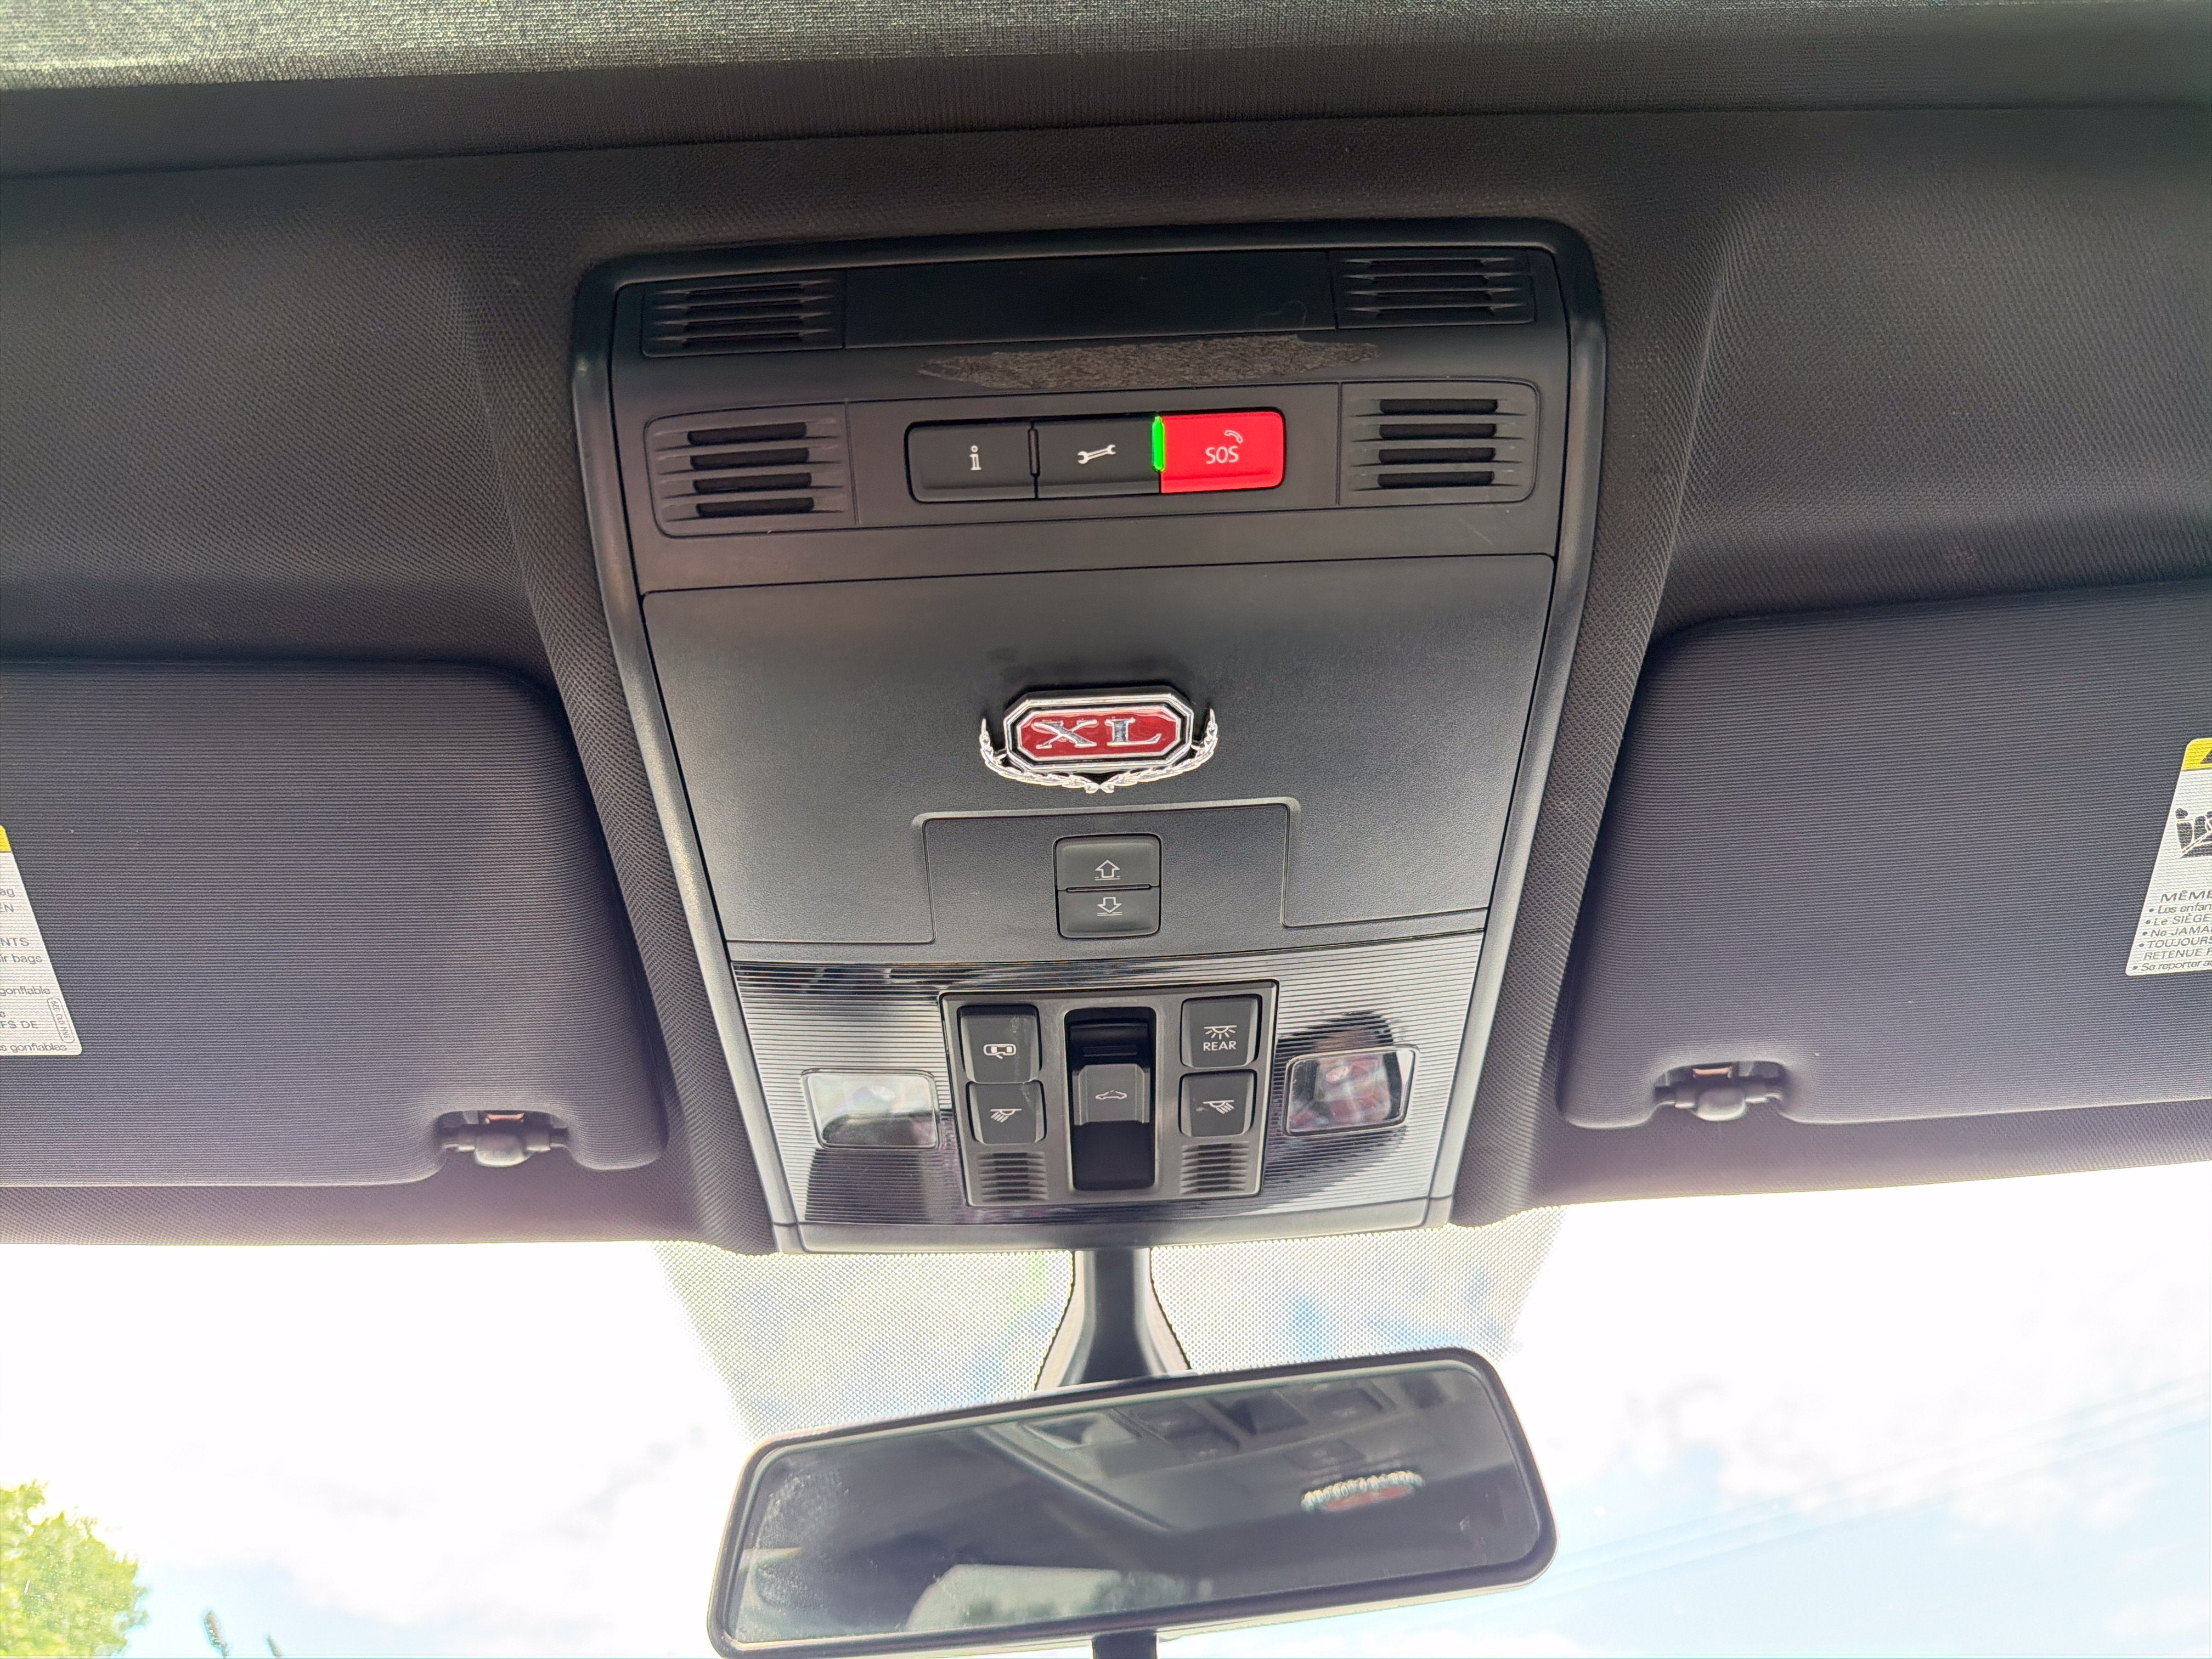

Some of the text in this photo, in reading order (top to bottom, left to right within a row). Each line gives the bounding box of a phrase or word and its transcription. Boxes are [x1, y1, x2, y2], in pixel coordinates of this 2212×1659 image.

[1205, 446, 1239, 464] SOS
[1031, 717, 1162, 749] XL
[12, 953, 43, 964] bags
[2144, 947, 2203, 960] RETENUE
[20, 1020, 40, 1029] DE
[1203, 1040, 1237, 1052] REAR
